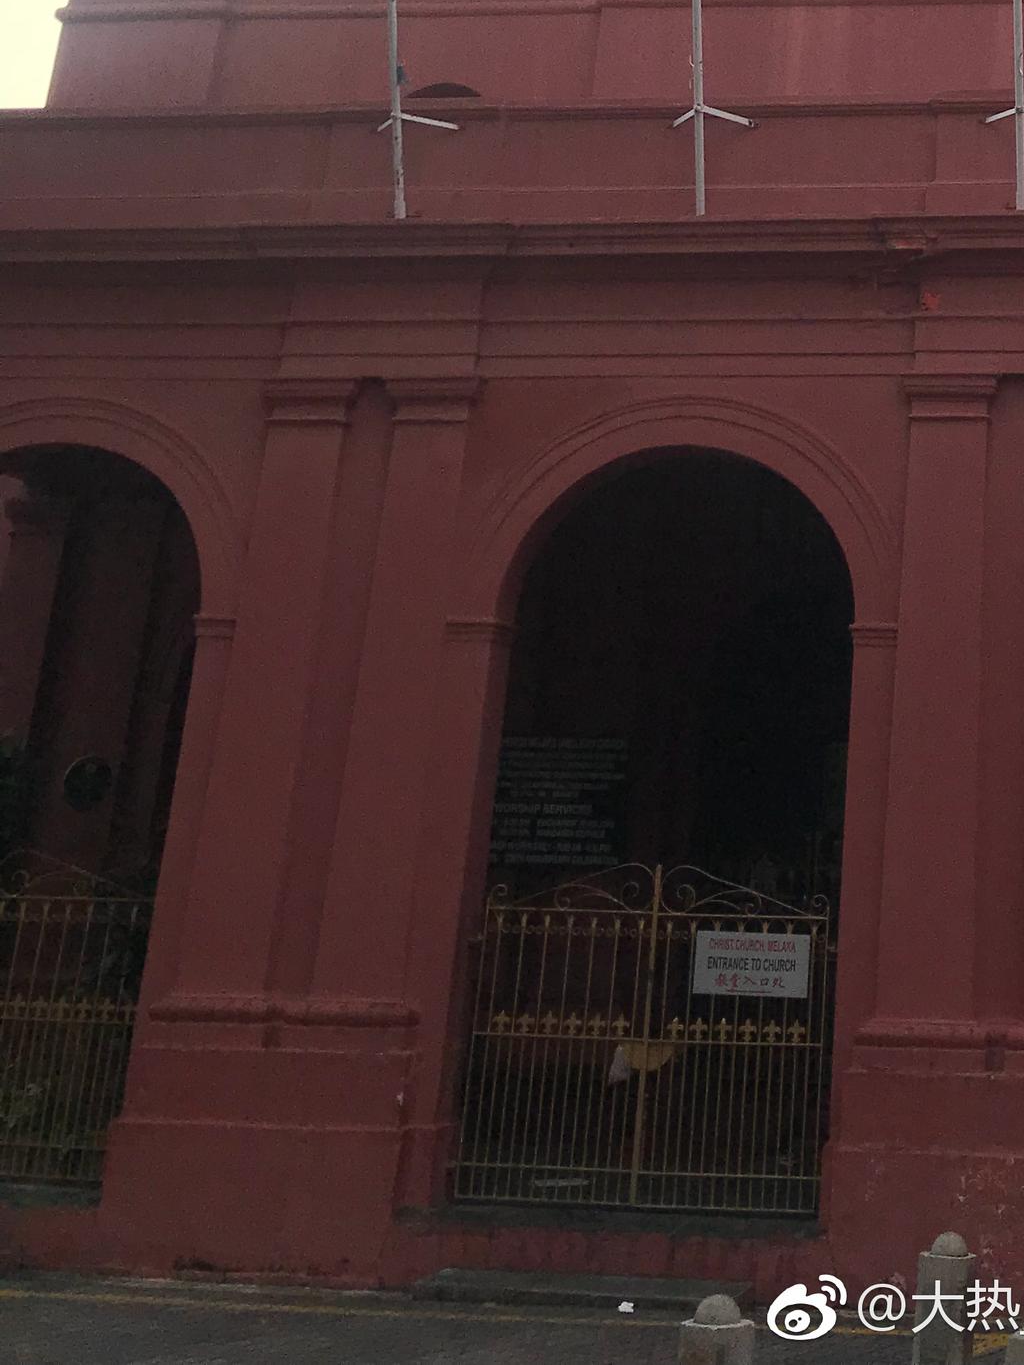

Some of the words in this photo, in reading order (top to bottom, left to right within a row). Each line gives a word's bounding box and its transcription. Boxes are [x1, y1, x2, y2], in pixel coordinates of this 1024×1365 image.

[767, 940, 797, 953] MELAKA
[707, 956, 749, 971] ENTRANCE
[750, 958, 761, 971] TO
[763, 958, 796, 972] CHURCH
